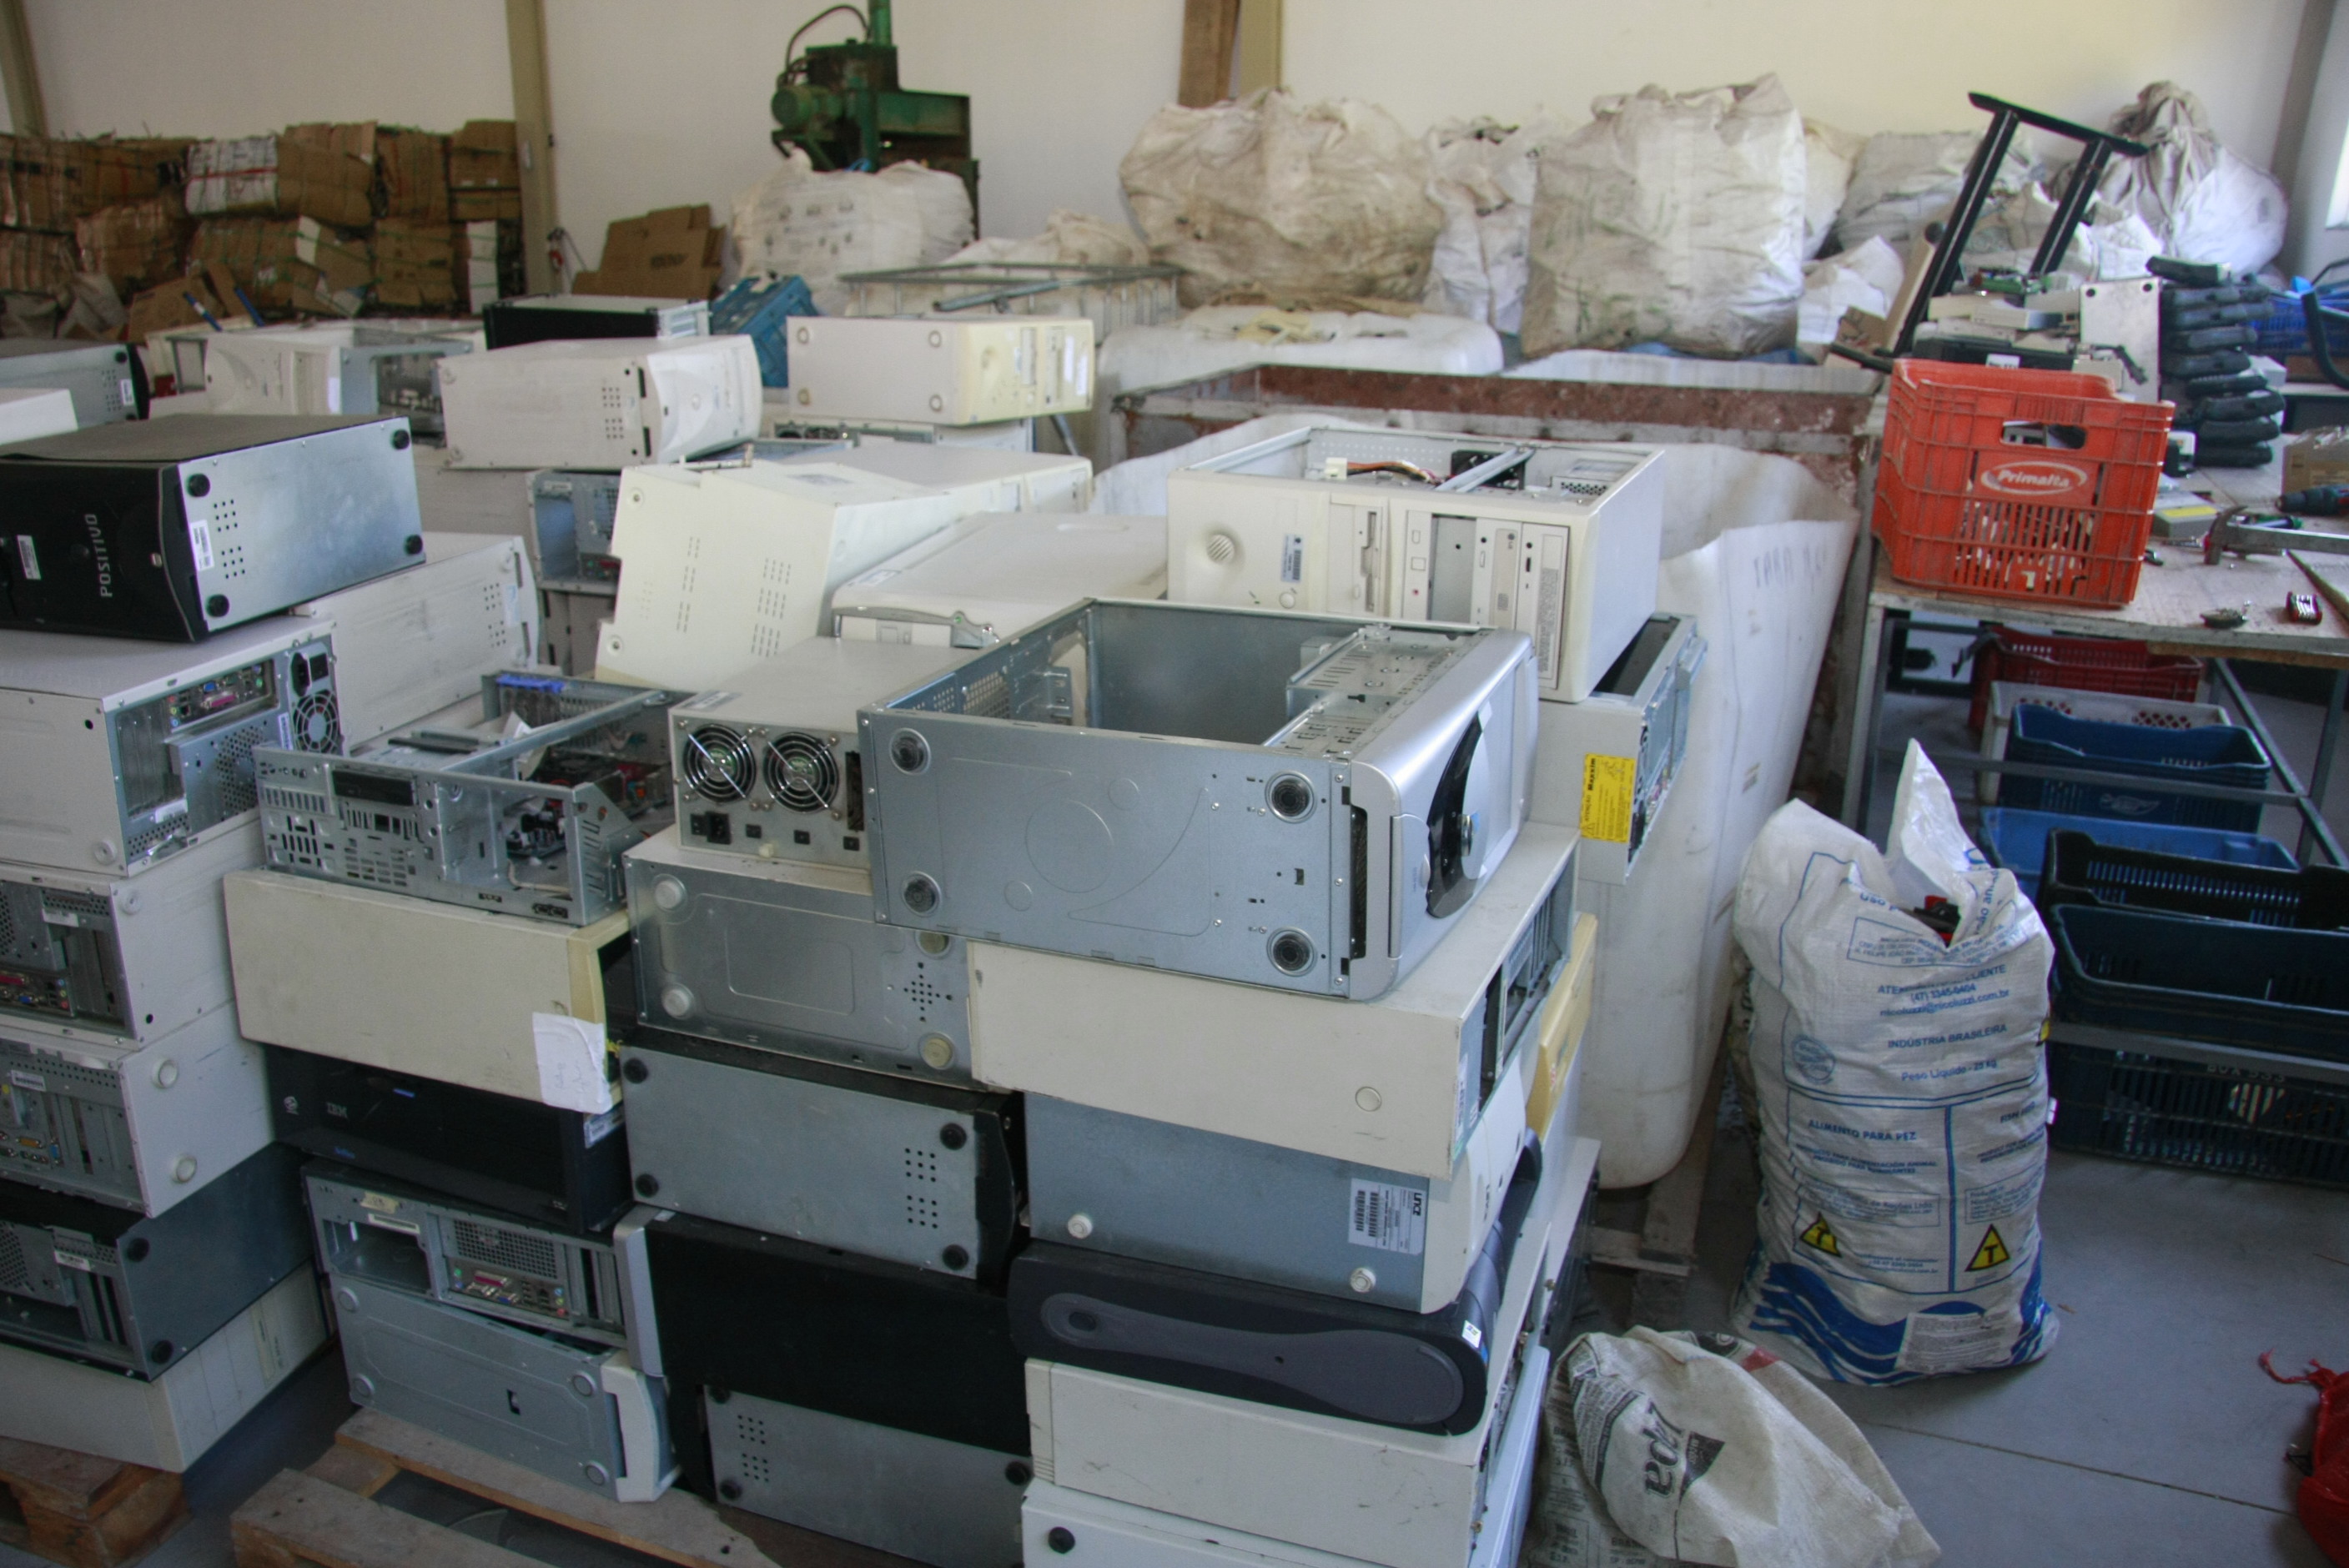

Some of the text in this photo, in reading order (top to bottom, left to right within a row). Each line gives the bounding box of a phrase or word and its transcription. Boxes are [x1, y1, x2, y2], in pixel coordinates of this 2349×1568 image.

[1998, 469, 2070, 489] Primalta
[84, 513, 113, 599] POSITIVO
[1948, 1023, 2008, 1043] BRASILEIRA
[1808, 1119, 1860, 1138] ALIMENTO
[1863, 1130, 1894, 1141] PARA
